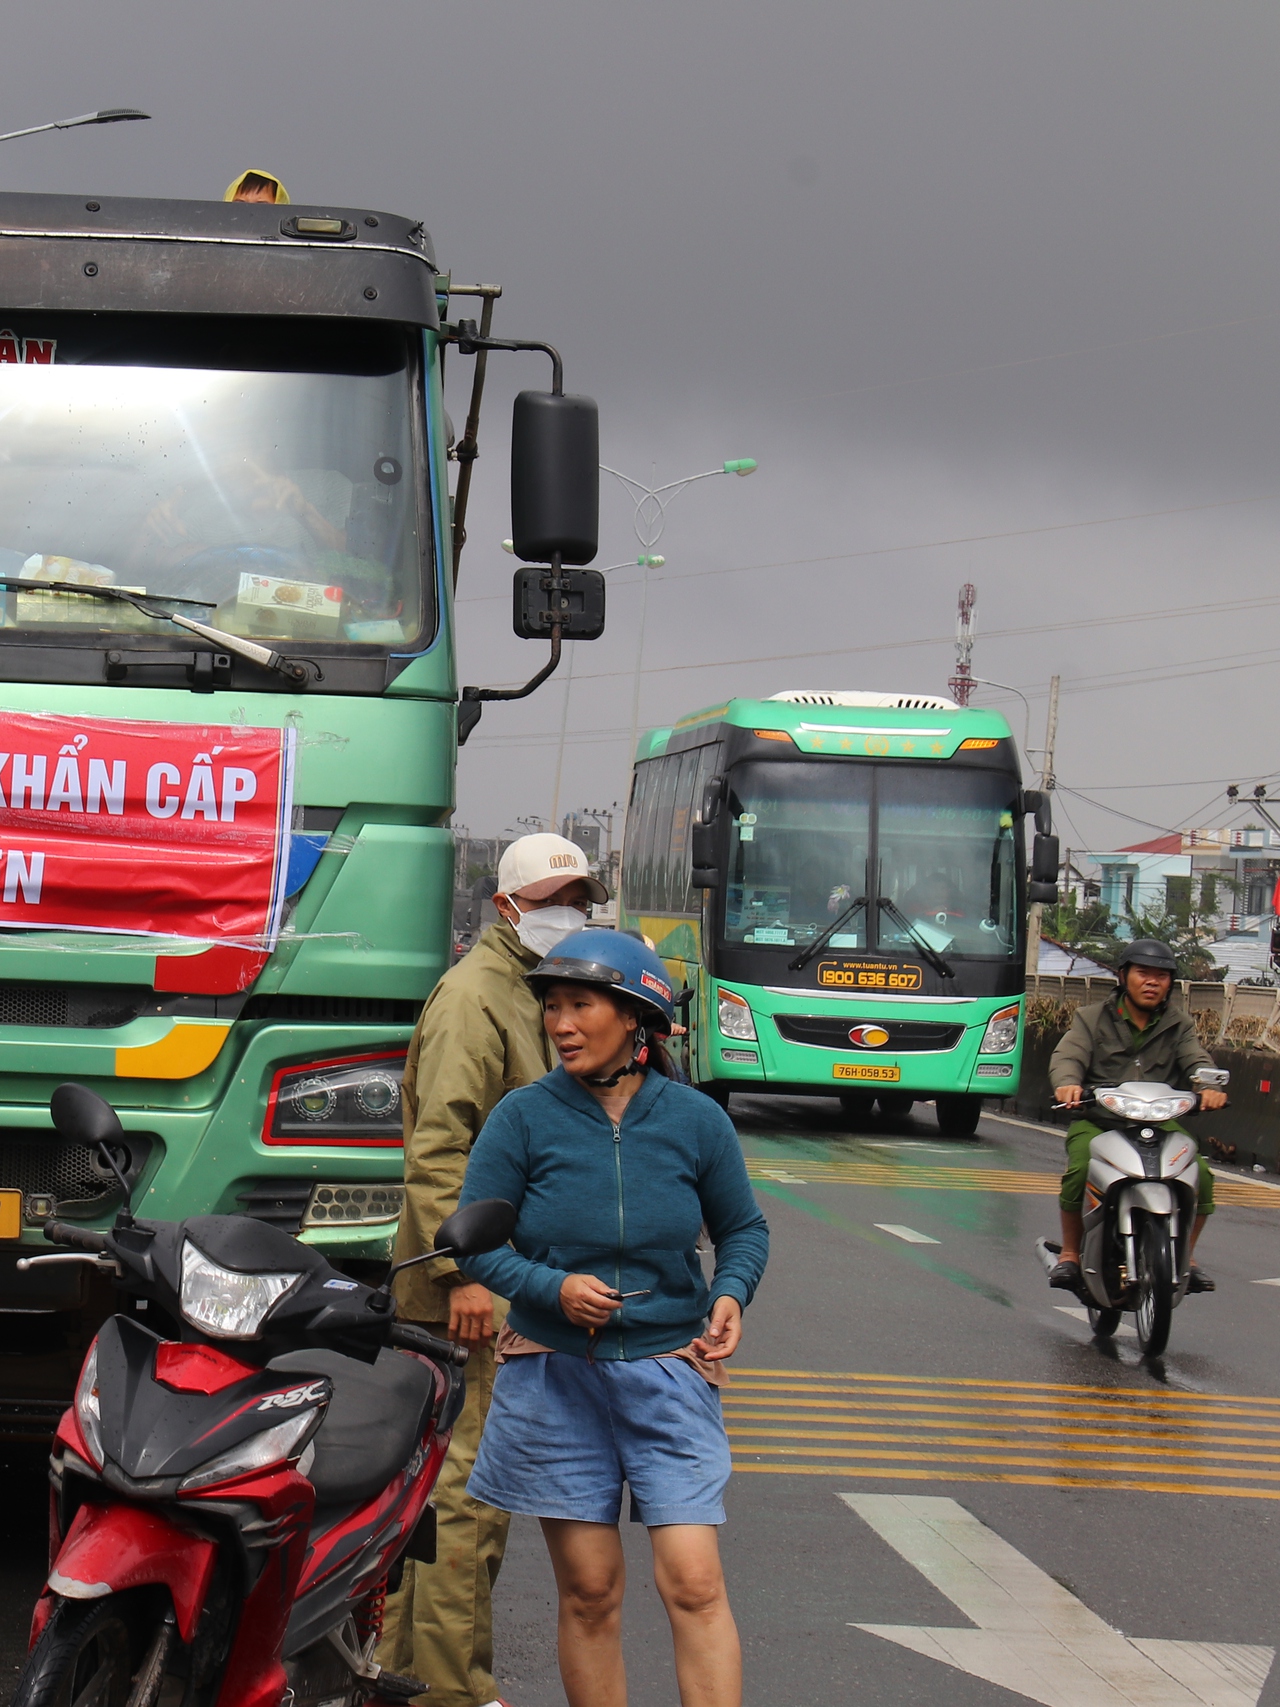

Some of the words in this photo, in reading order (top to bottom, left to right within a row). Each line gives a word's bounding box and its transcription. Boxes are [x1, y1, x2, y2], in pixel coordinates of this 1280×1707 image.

[145, 746, 257, 823] CẤP
[843, 961, 898, 971] www.tuantu.vn
[822, 970, 855, 985] 1900
[858, 972, 886, 986] 636
[888, 973, 918, 988] 607
[839, 1066, 895, 1079] 76H-058.53
[257, 1380, 326, 1412] RSX
